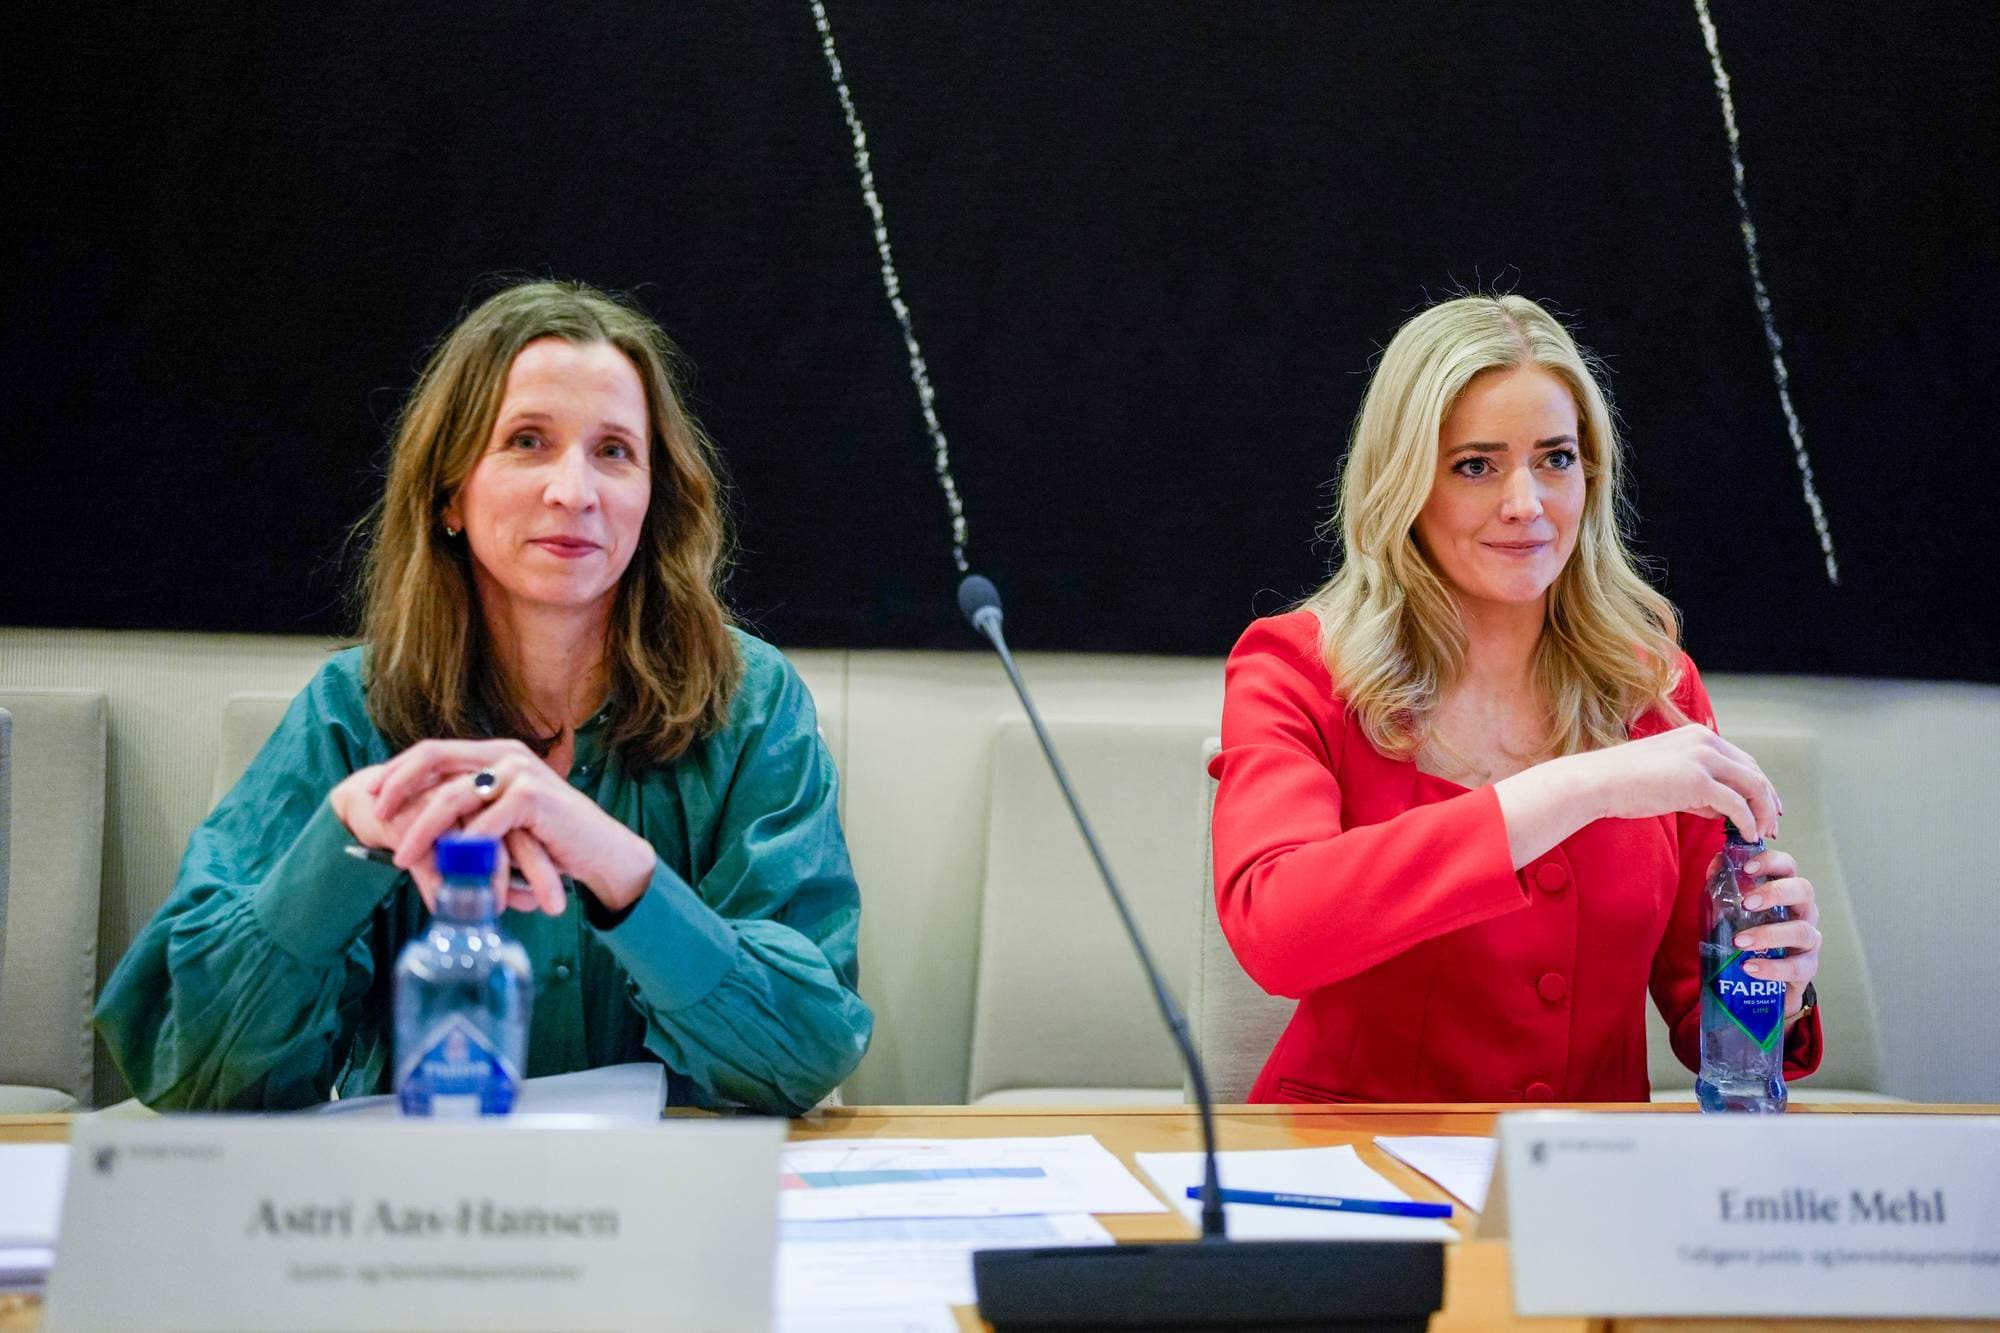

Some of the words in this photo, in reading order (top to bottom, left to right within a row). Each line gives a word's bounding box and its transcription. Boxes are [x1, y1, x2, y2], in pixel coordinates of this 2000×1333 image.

[245, 1198, 351, 1238] Astri
[364, 1198, 619, 1238] Aas-Hansen
[1717, 1188, 1840, 1223] Emilie
[1849, 1188, 1947, 1225] Mehl
